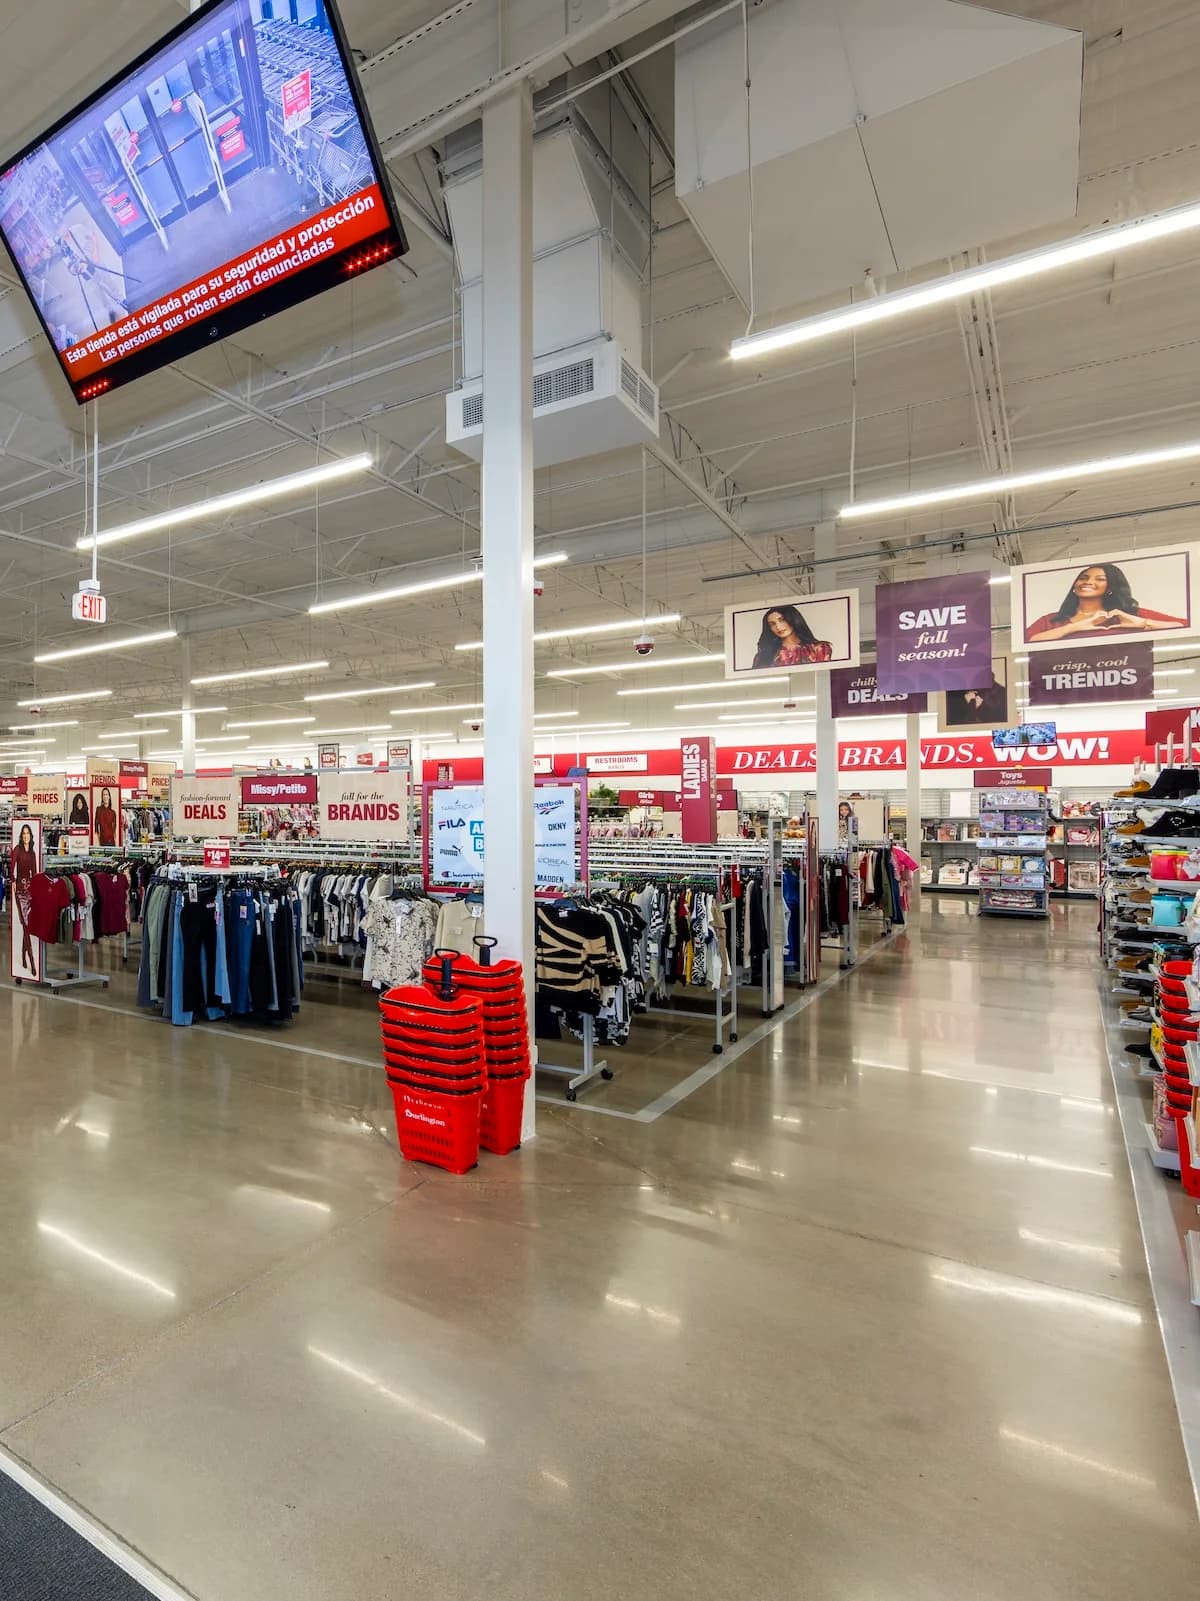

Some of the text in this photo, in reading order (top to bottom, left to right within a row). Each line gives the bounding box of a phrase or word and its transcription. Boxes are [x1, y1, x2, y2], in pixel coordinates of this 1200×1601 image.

[66, 194, 375, 363] Esta tienda está vigilada para su seguridad y protección
[99, 235, 336, 363] Las personas que roben serán denunciadas
[82, 595, 102, 620] EXIT
[899, 605, 967, 630] SAVE
[914, 630, 949, 649] fall
[898, 643, 968, 662] season!
[1052, 655, 1129, 673] crisp, cool
[1042, 668, 1138, 690] TRENDS
[990, 737, 1110, 762] WOW!
[594, 756, 638, 764] RESTROOMS
[682, 743, 700, 799] LADIES
[1000, 771, 1023, 780] Toys
[91, 775, 116, 785] TRENDS
[251, 784, 307, 796] Missy/Petite
[341, 791, 384, 802] fall for the
[32, 793, 59, 804] PRICES
[180, 794, 231, 803] fashion-forward
[184, 804, 226, 820] DEALS
[327, 803, 400, 821] BRANDS
[441, 803, 474, 812] NAUTICA
[438, 817, 466, 831] FILA
[548, 822, 567, 831] DKNY
[441, 871, 484, 880] Champio
[537, 874, 564, 883] MADDEN
